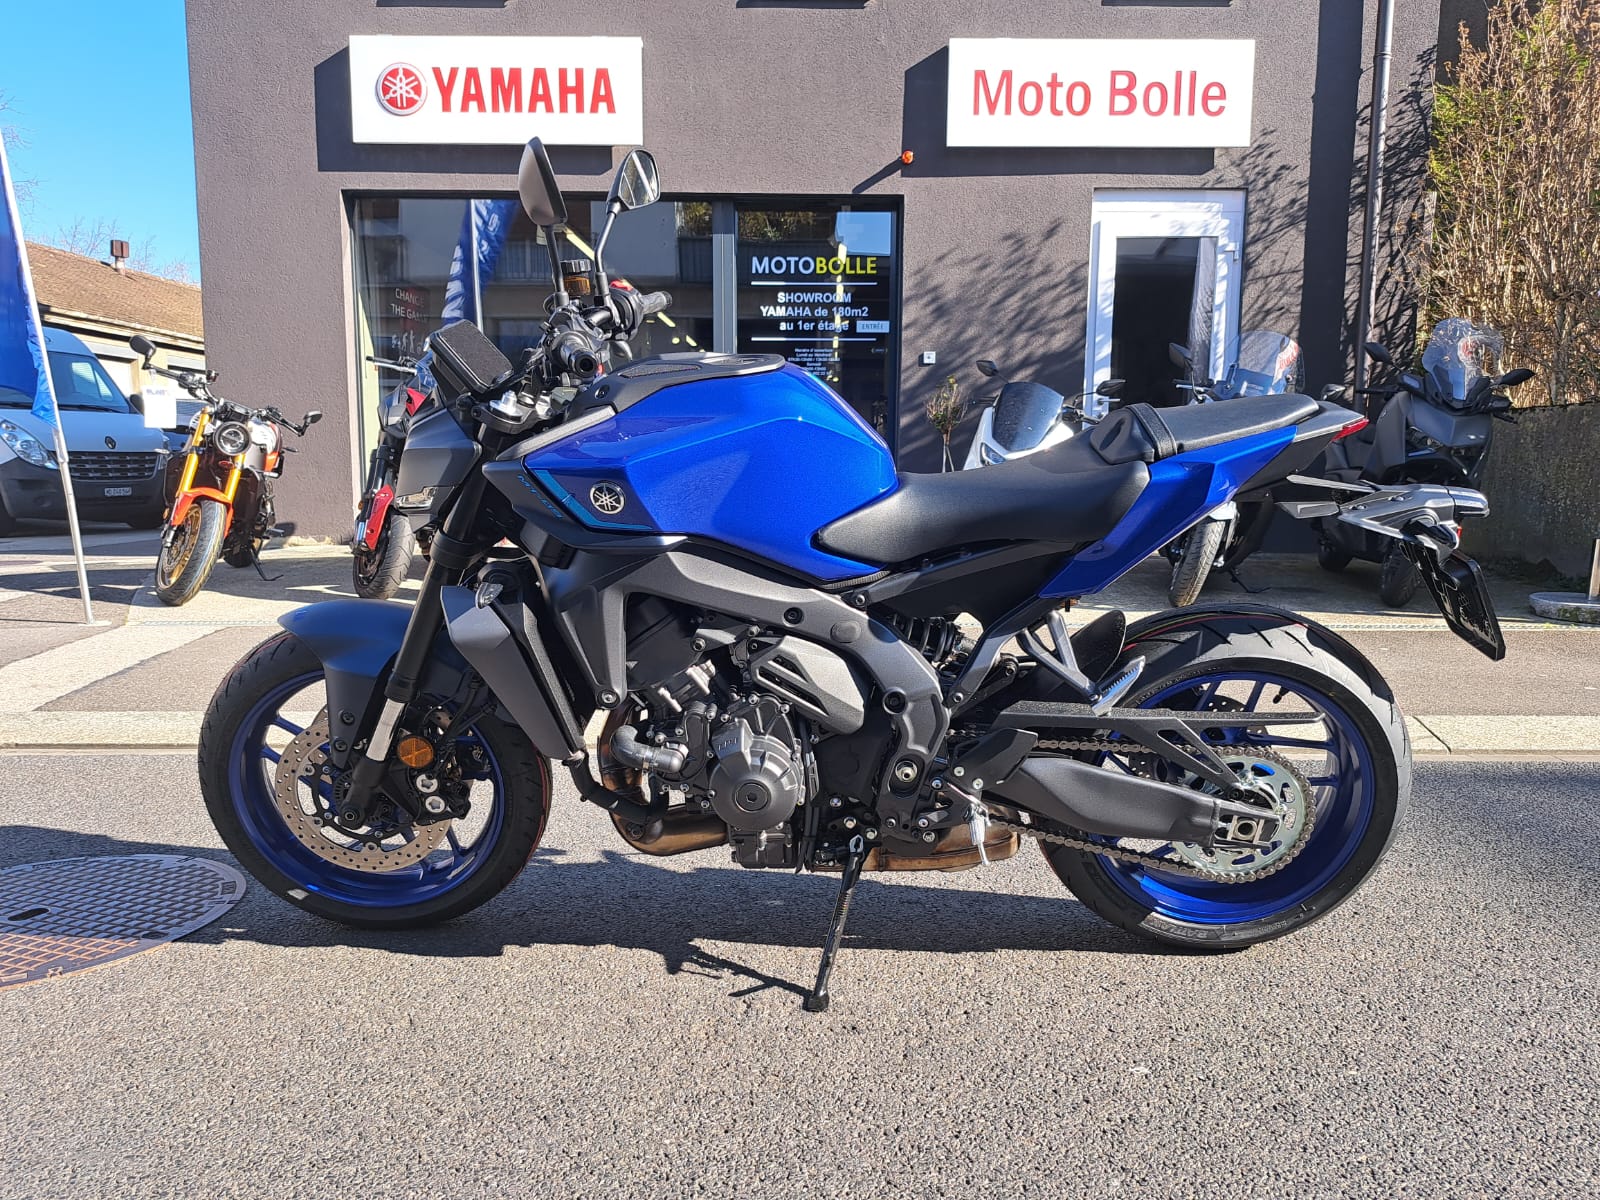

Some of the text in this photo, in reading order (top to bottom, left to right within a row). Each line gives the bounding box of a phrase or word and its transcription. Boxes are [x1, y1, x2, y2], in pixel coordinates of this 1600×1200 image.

[432, 67, 616, 114] YAMAHA
[973, 69, 1227, 117] Moto Bolle
[751, 256, 877, 274] MOTOBOLLE
[777, 292, 851, 303] SHOWROOM
[389, 303, 406, 318] THE
[760, 306, 869, 317] YAMAHA de 180m2
[779, 321, 849, 333] au 1er étage
